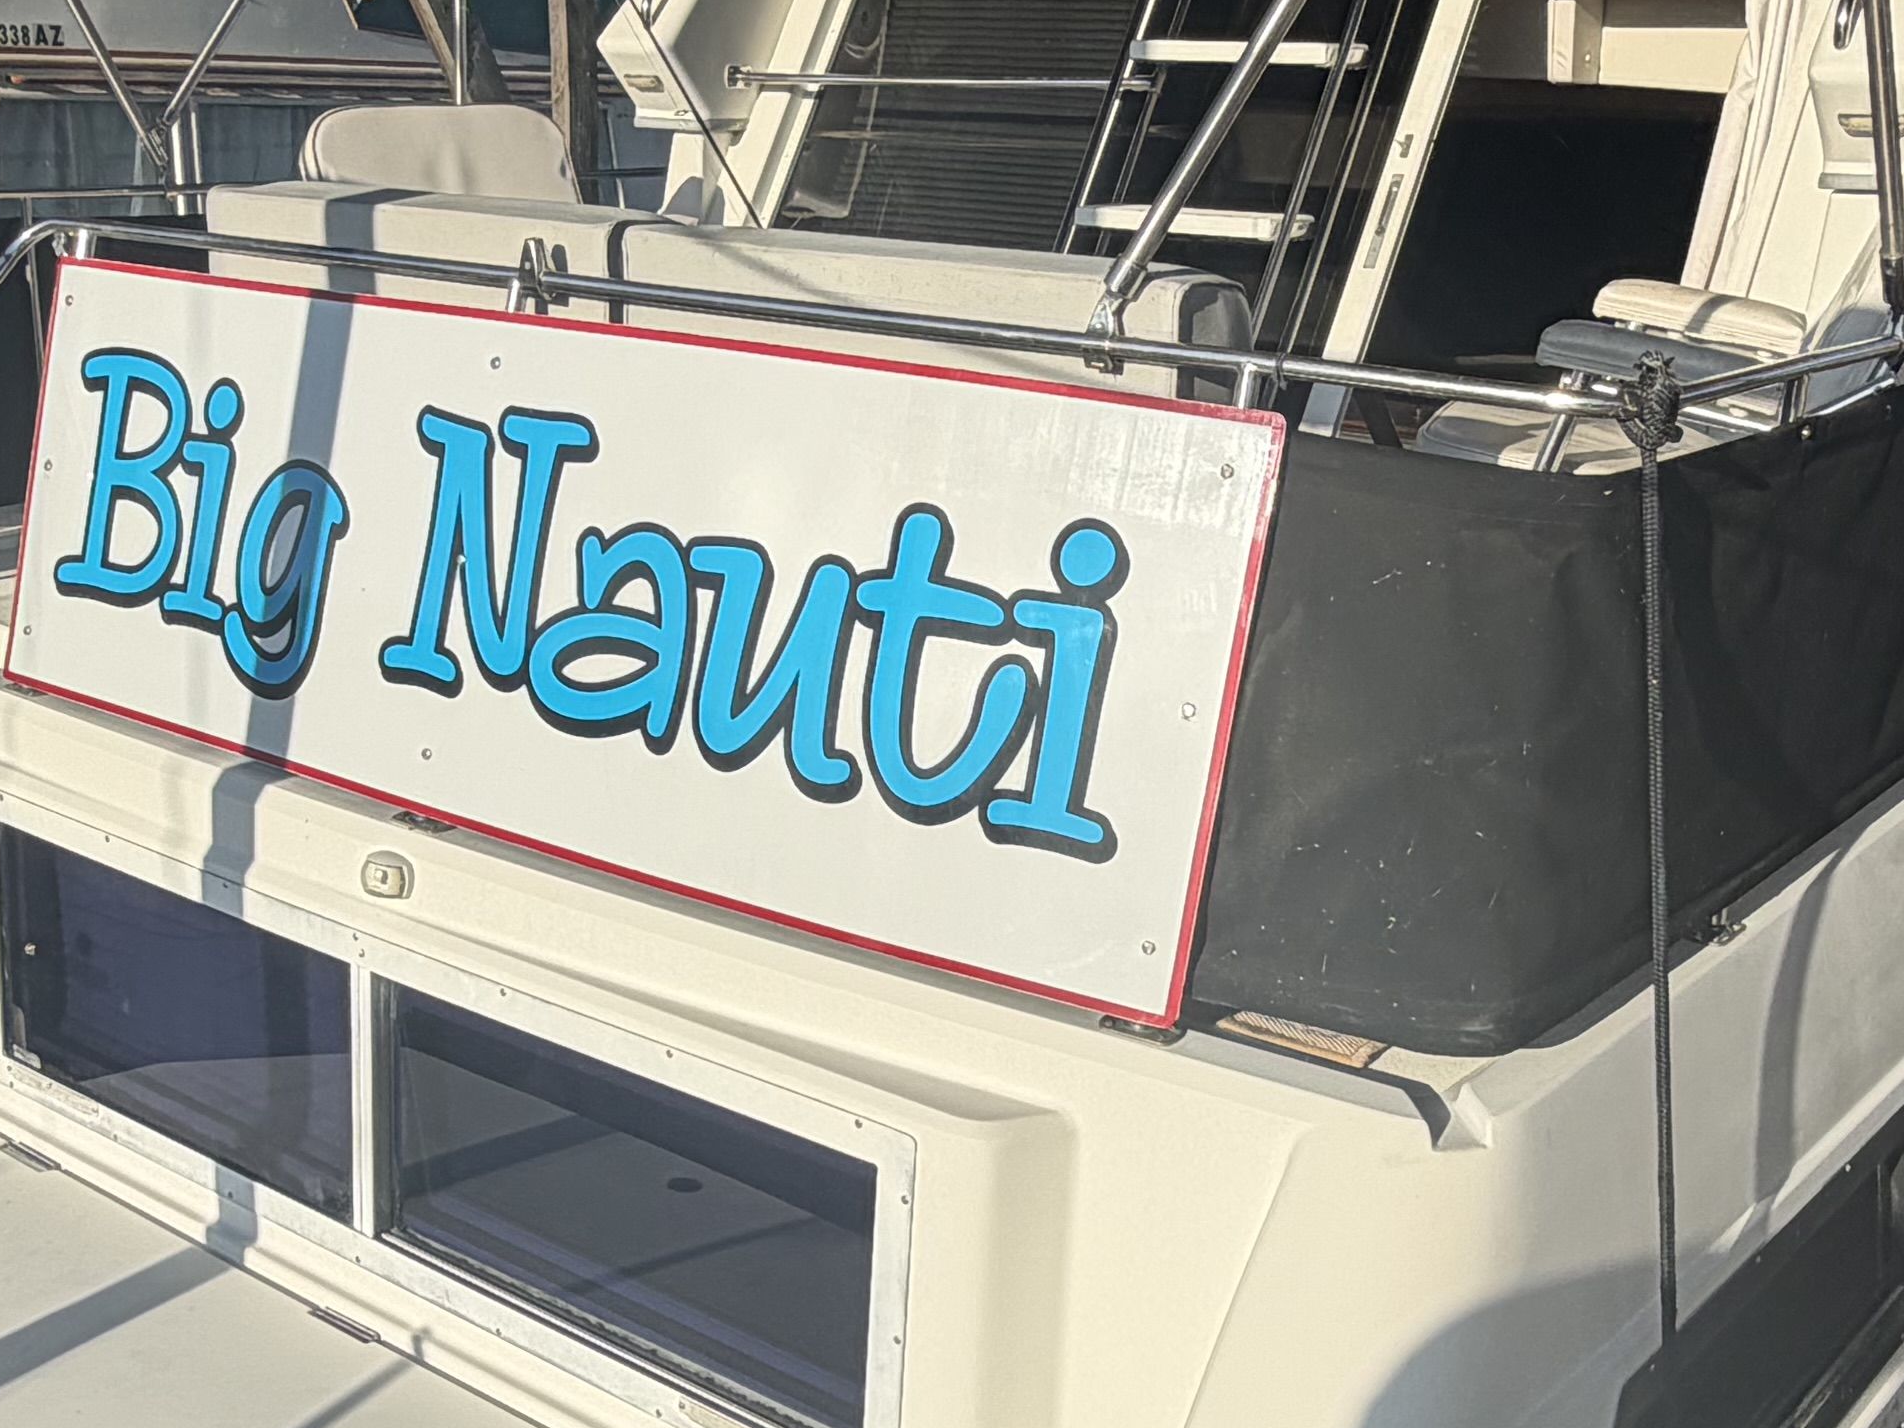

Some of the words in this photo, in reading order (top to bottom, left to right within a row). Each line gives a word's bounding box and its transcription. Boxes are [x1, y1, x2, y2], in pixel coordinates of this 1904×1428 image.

[35, 23, 65, 47] AZ
[53, 346, 349, 700] Big
[381, 406, 1130, 863] Nauti
